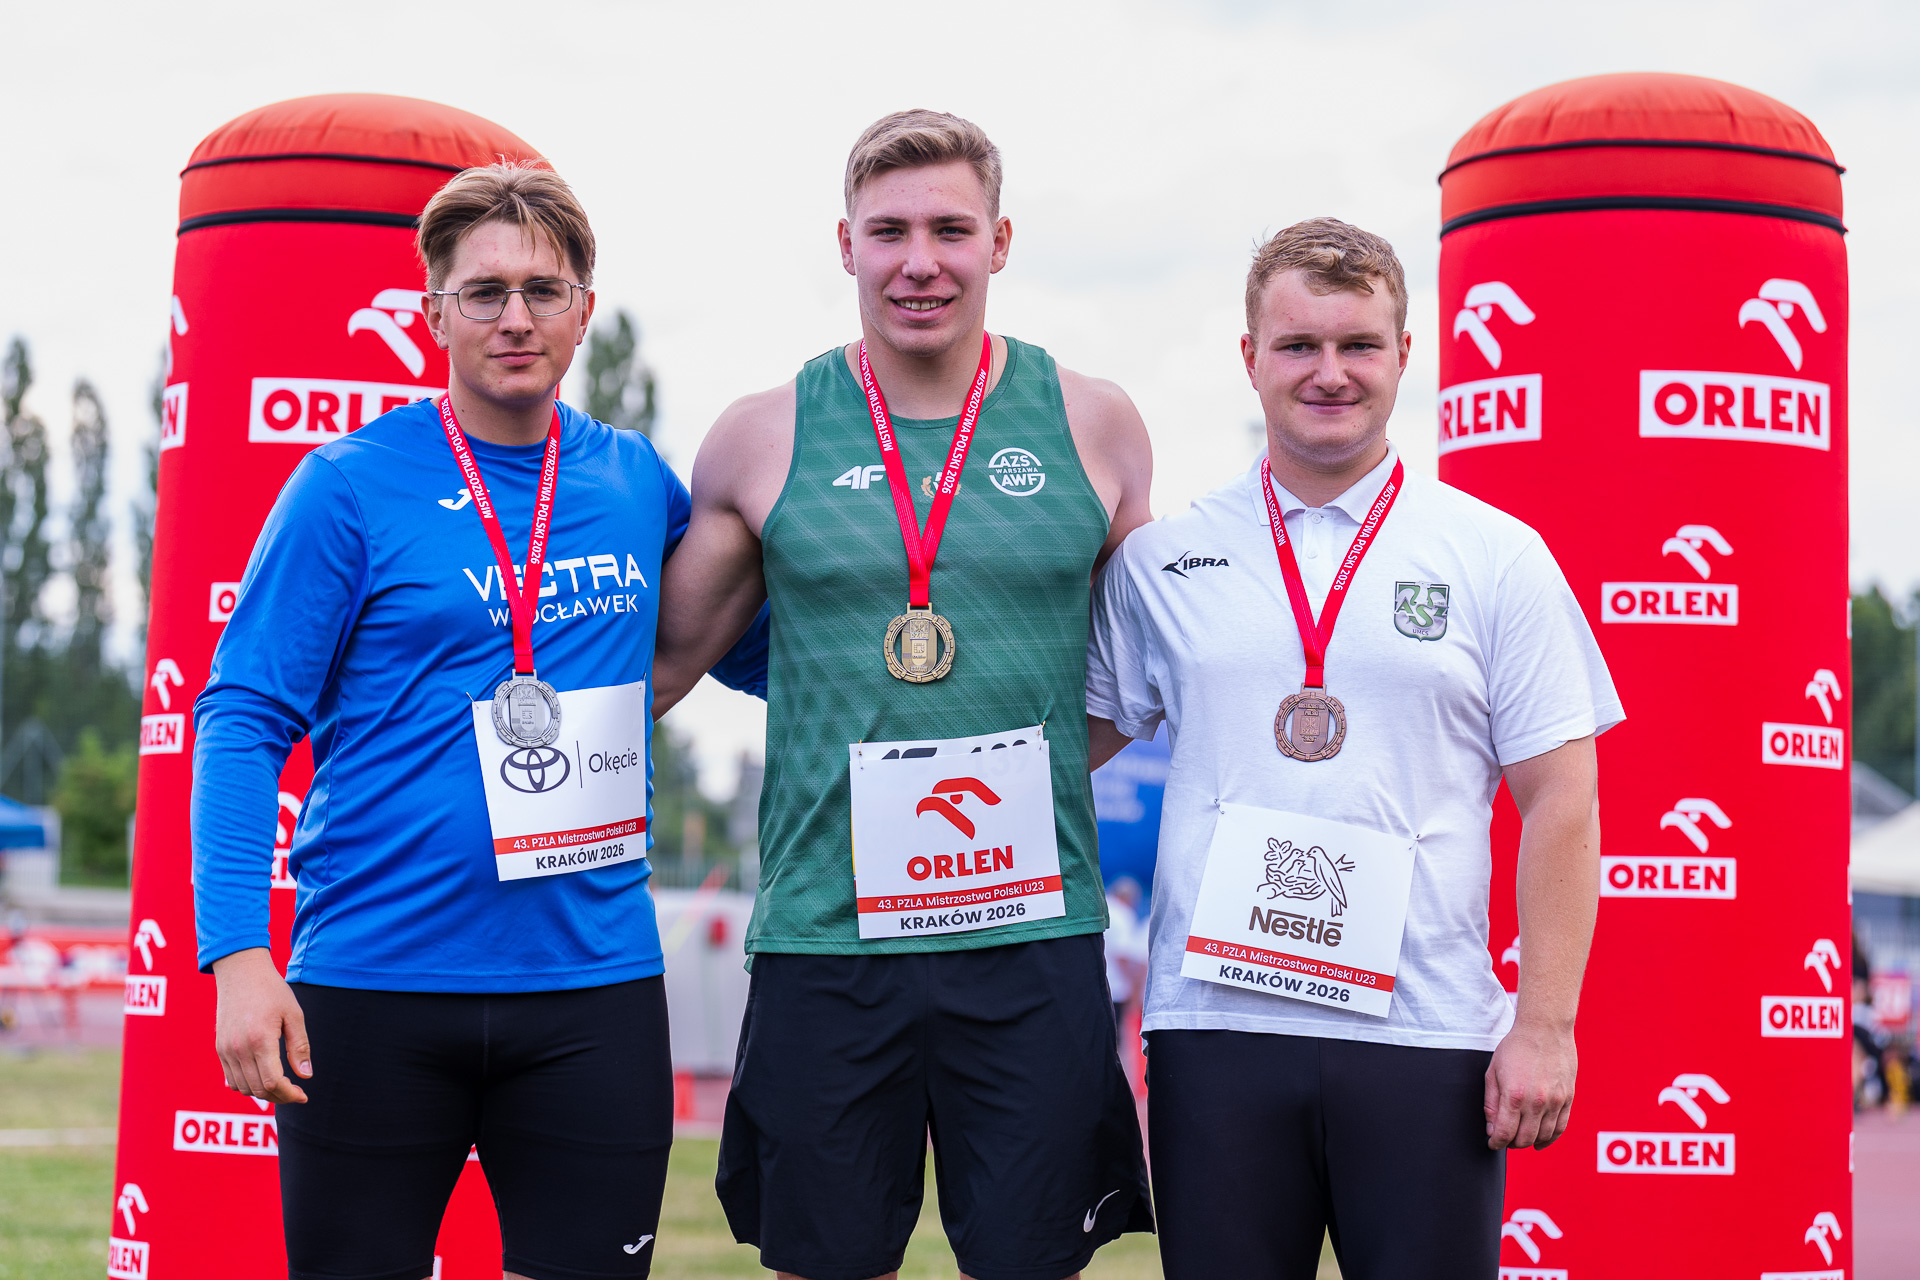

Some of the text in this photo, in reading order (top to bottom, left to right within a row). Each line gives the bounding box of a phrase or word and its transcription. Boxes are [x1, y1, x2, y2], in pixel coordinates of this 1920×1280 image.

[867, 386, 893, 451] MISTRZOSTWA
[1440, 387, 1527, 441] RLEN
[1654, 382, 1821, 436] ORLEN
[445, 418, 466, 452] POLSKI
[941, 368, 987, 494] MISTRZOSTWA POLSKI 2026
[1000, 455, 1031, 467] AZS
[459, 451, 494, 519] MISTRZOSTWA
[832, 465, 887, 489] 4F
[1002, 473, 1038, 486] AWF
[530, 437, 558, 565] MISTRZOSTWA POLSKI 2026
[1265, 486, 1287, 547] MISTRZOSTWA
[1333, 482, 1396, 591] MISTRZOSTWA POLSKI 2026
[488, 594, 638, 627] WCŁAWEK
[1610, 590, 1728, 617] ORLEN
[1770, 731, 1839, 760] ORLEN
[588, 748, 638, 774] Okęcie
[513, 821, 637, 850] 43. PZLA Mistrzostwa Polski U23
[535, 843, 625, 870] KRAKÓW 2026
[906, 845, 1014, 881] ORLEN
[1608, 863, 1727, 891] ORLEN
[877, 881, 1045, 910] 43. PZLA Mistrzostwa Polski U23
[900, 903, 1026, 930] KRAKÓW 2026
[1204, 942, 1377, 986] 43. PZLA Mistrzostwa Polski U23
[1219, 964, 1350, 1002] KRAKÓW 2026
[1768, 1004, 1839, 1030] ORLEN
[181, 1118, 279, 1148] ORLEN
[1606, 1139, 1725, 1167] ORLEN
